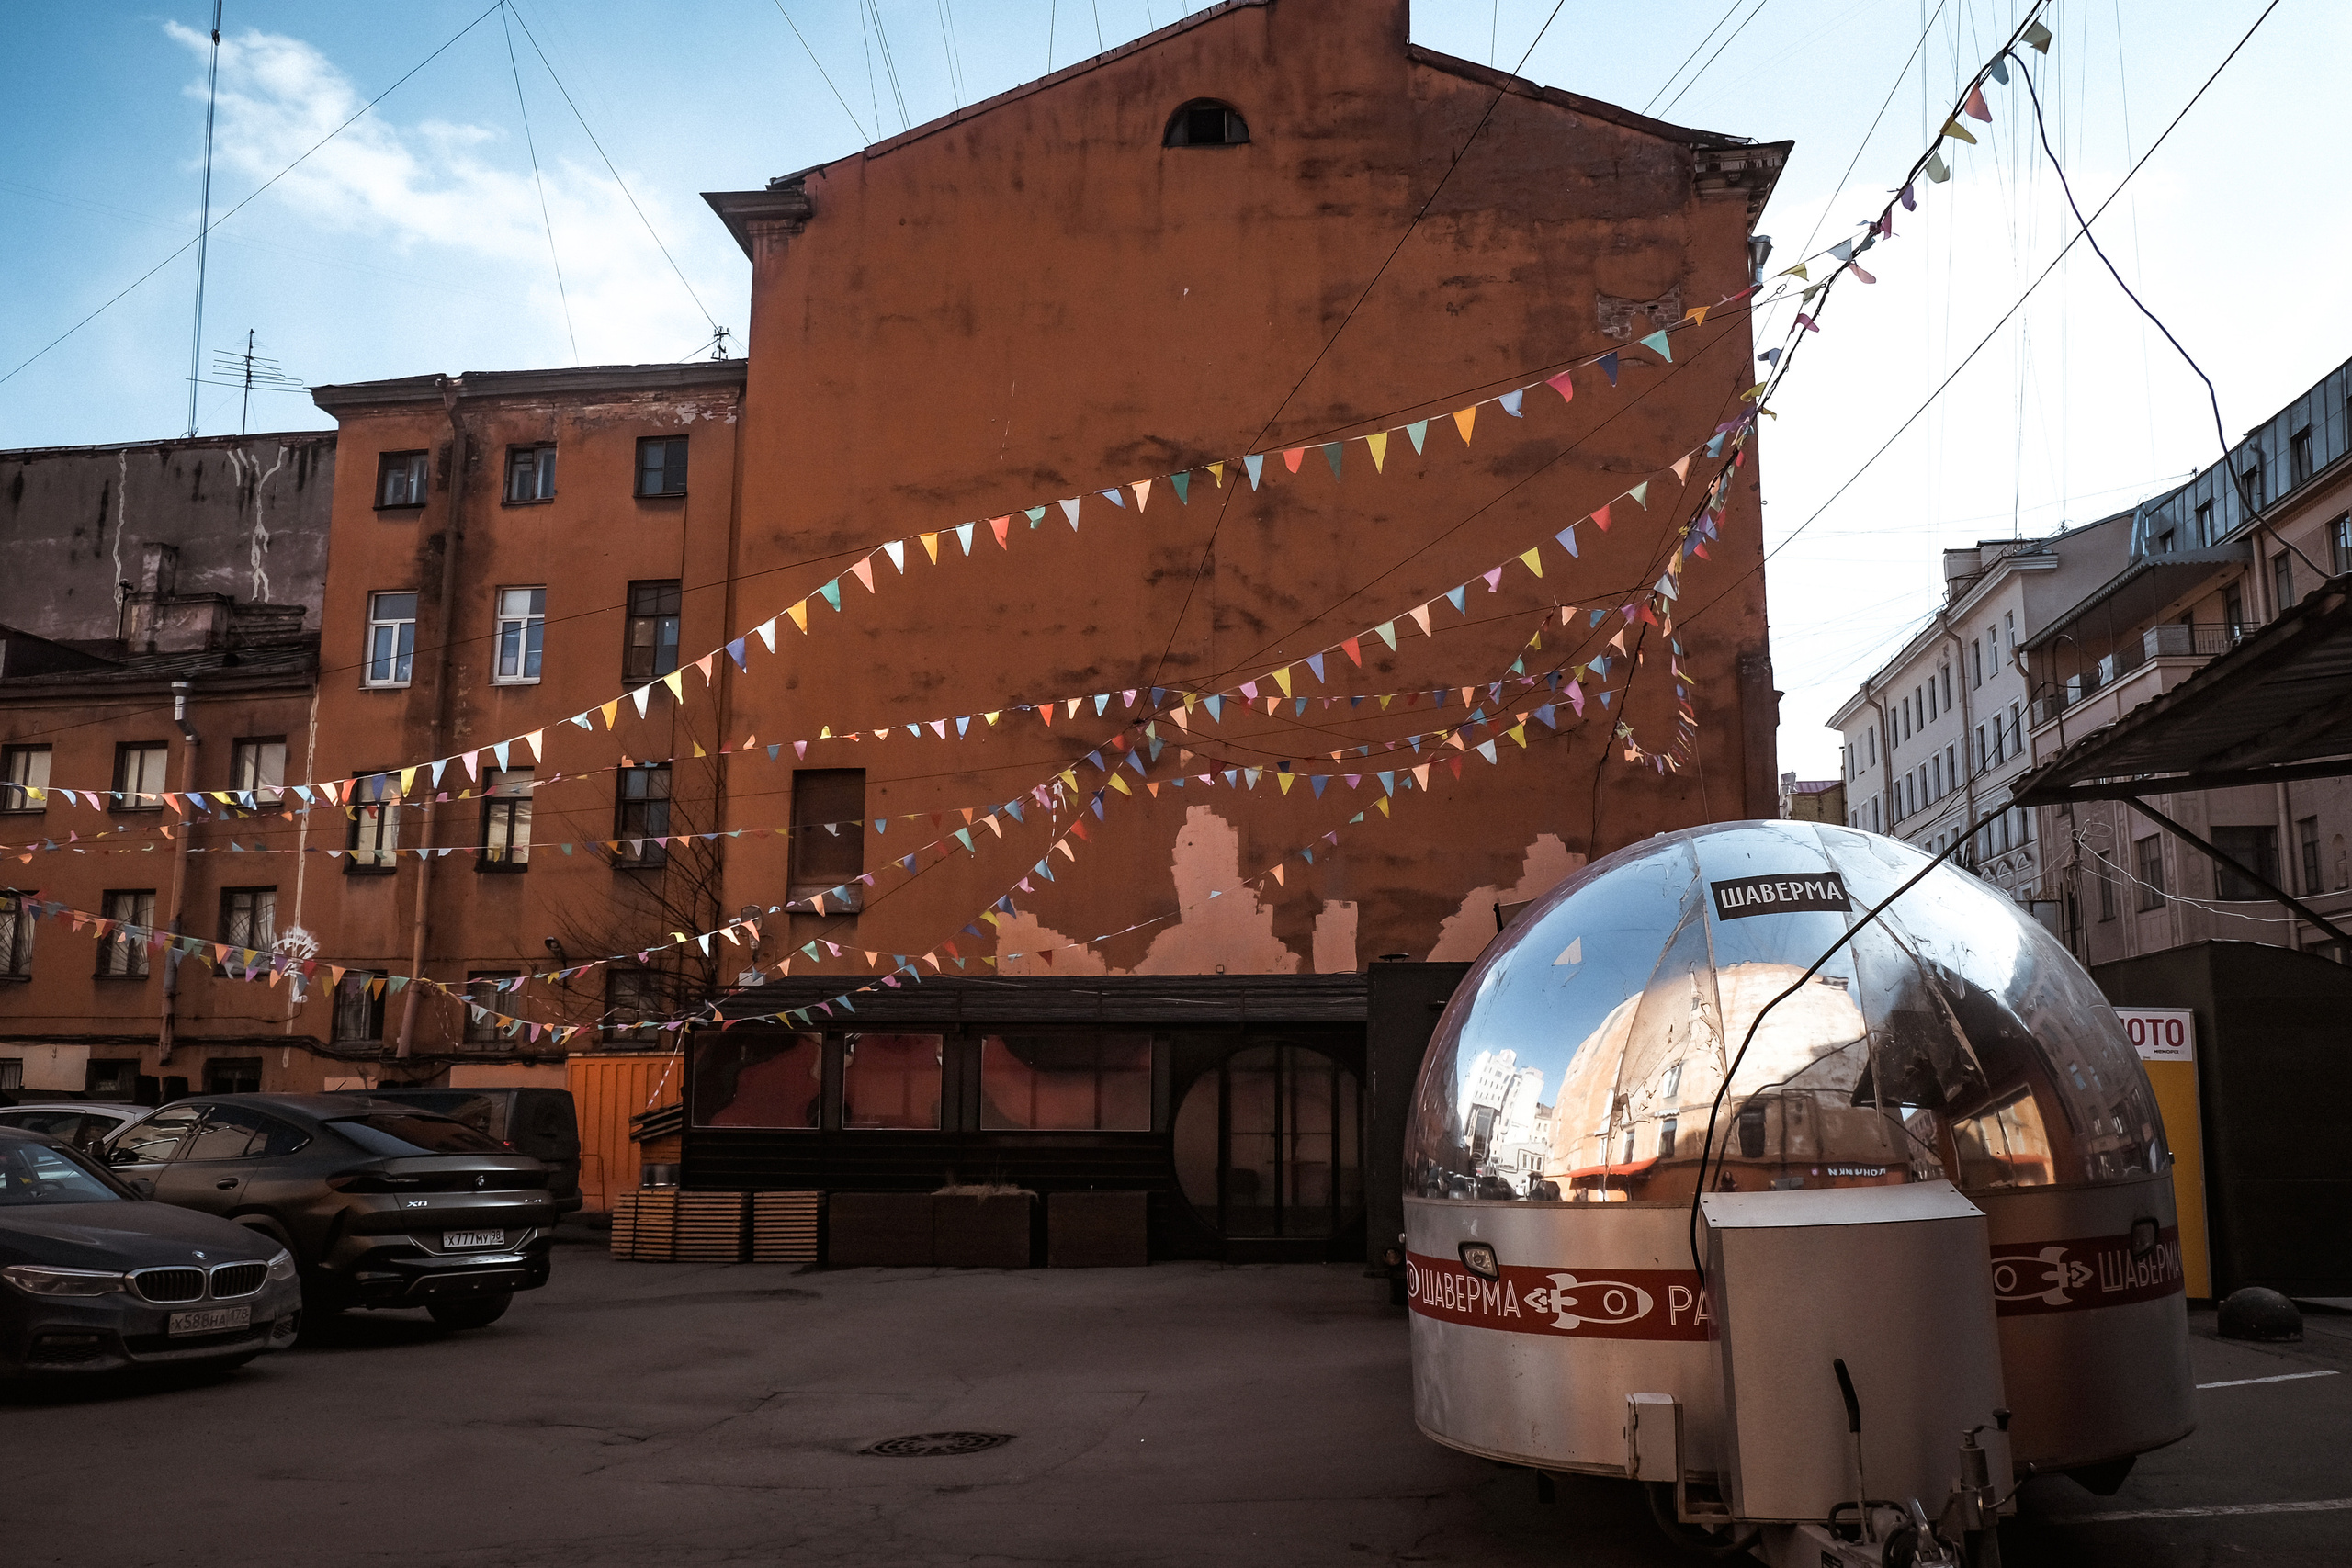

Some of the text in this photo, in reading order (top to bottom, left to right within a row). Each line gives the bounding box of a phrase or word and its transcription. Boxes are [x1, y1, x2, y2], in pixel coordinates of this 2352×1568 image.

[1721, 881, 1844, 908] ШАВЕРМА
[2120, 1018, 2185, 1047] OTO
[1421, 1268, 1521, 1318] ШАВЕРМА
